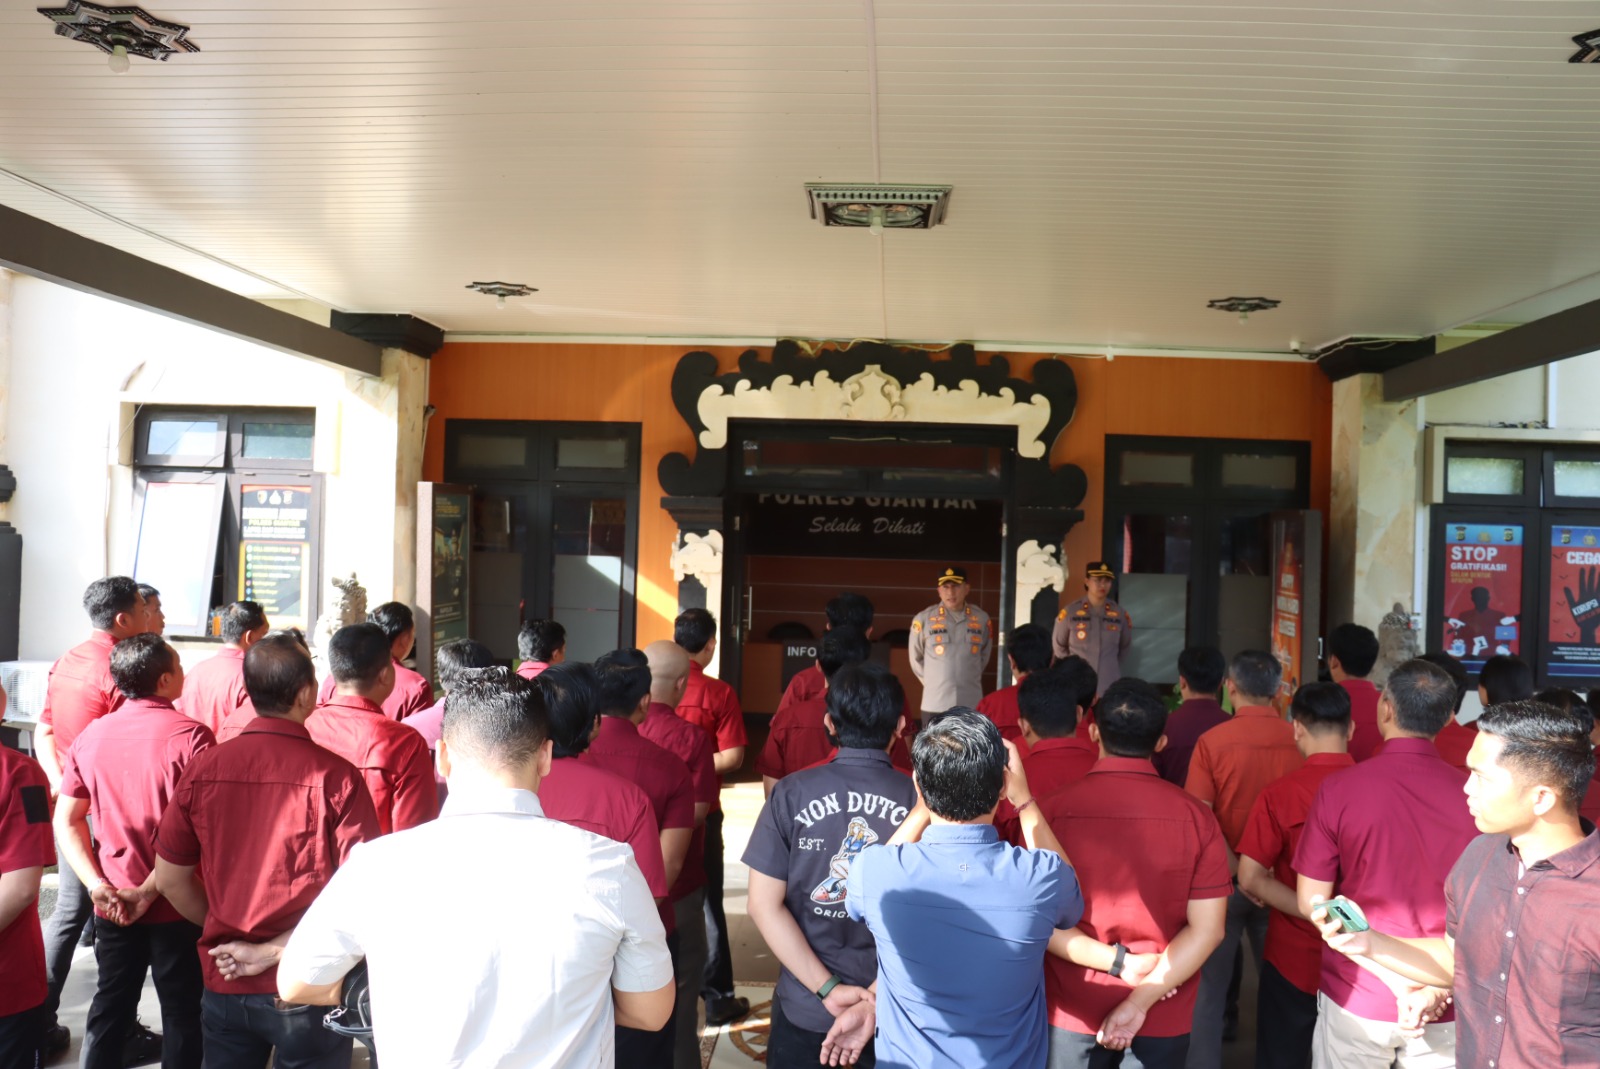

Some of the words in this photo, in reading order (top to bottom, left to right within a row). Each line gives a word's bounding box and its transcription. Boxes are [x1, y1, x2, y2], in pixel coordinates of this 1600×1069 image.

[808, 516, 862, 533] Selalu
[873, 517, 925, 535] Dihati
[1451, 546, 1498, 561] STOP
[787, 646, 817, 657] INFO
[794, 792, 842, 828] VON
[798, 837, 827, 851] EST.
[813, 906, 851, 918] ORIG
